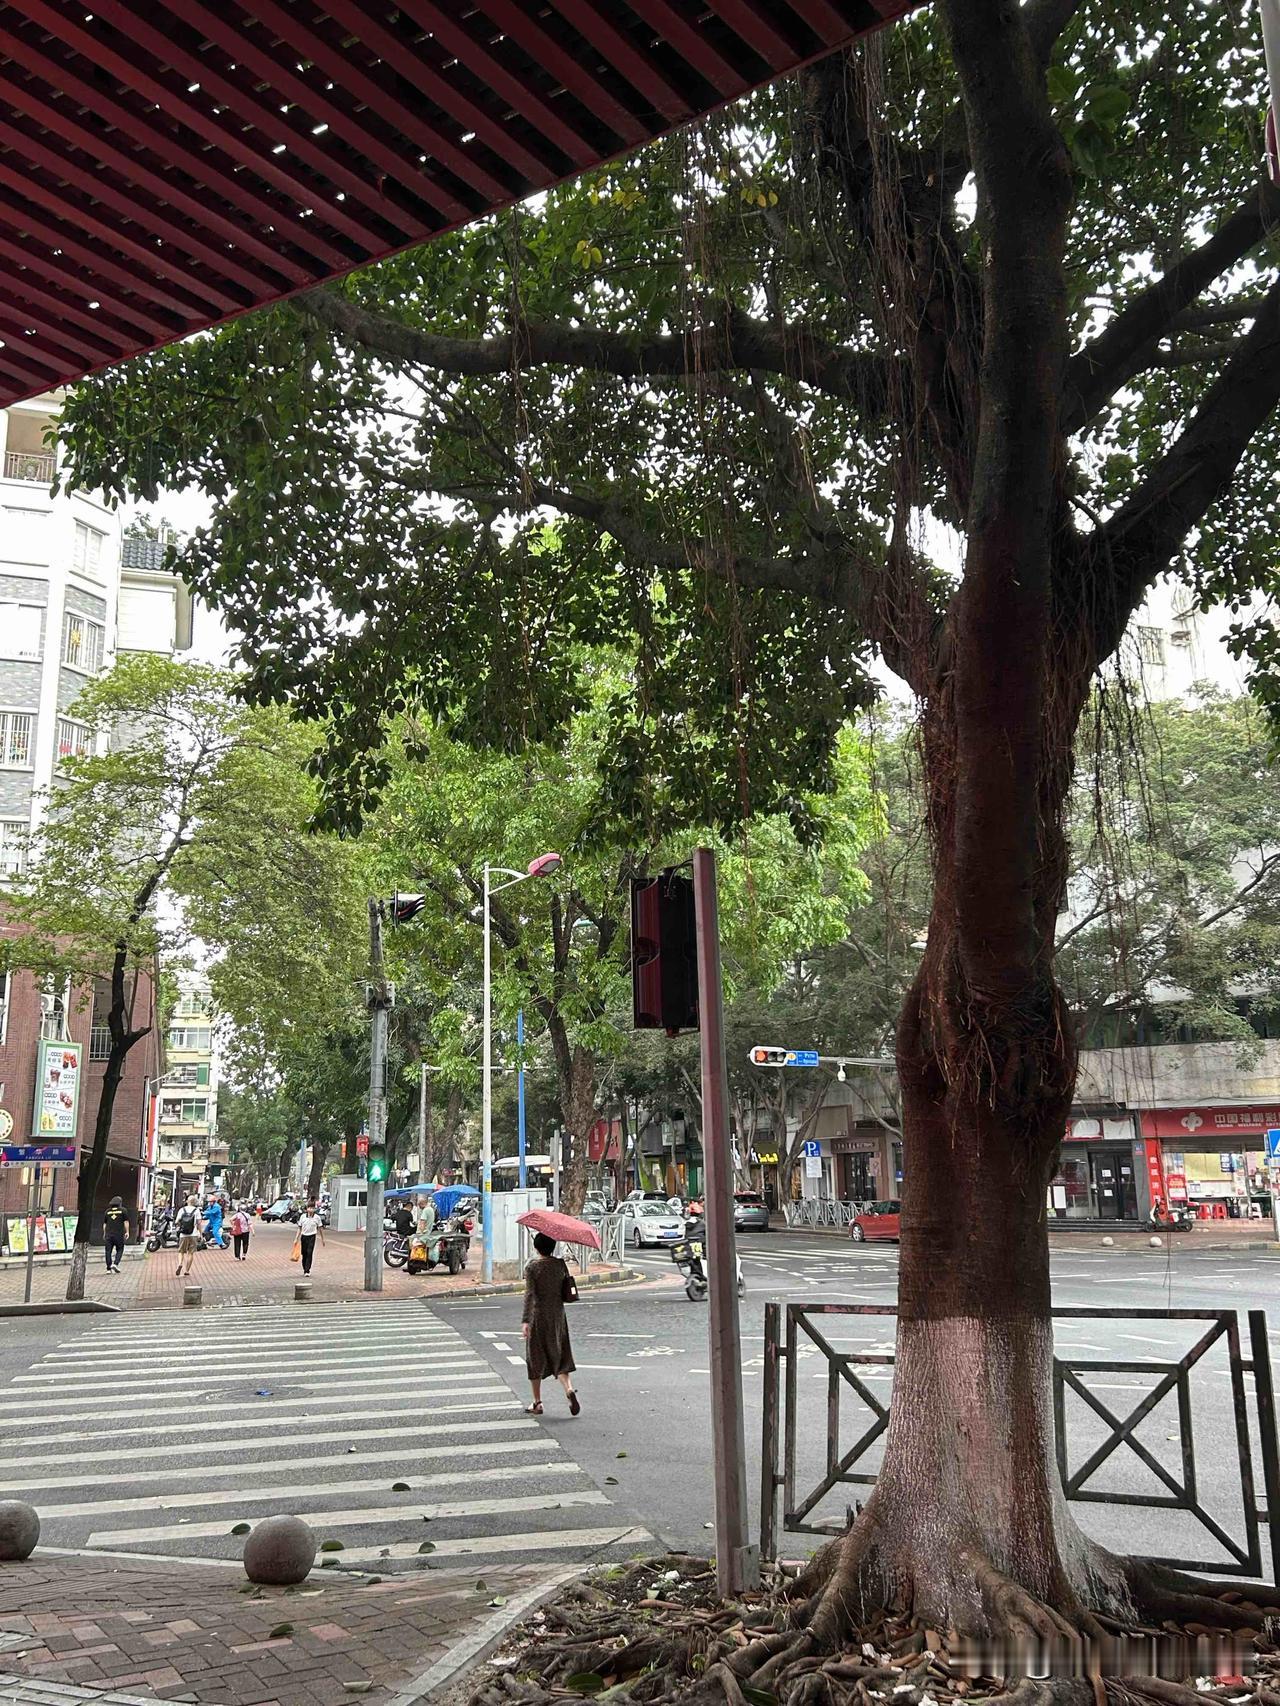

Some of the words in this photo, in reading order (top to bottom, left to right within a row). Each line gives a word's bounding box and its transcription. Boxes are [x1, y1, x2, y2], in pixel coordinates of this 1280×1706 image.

[1214, 1112, 1280, 1123] 中国福利彩
[806, 1141, 817, 1157] P
